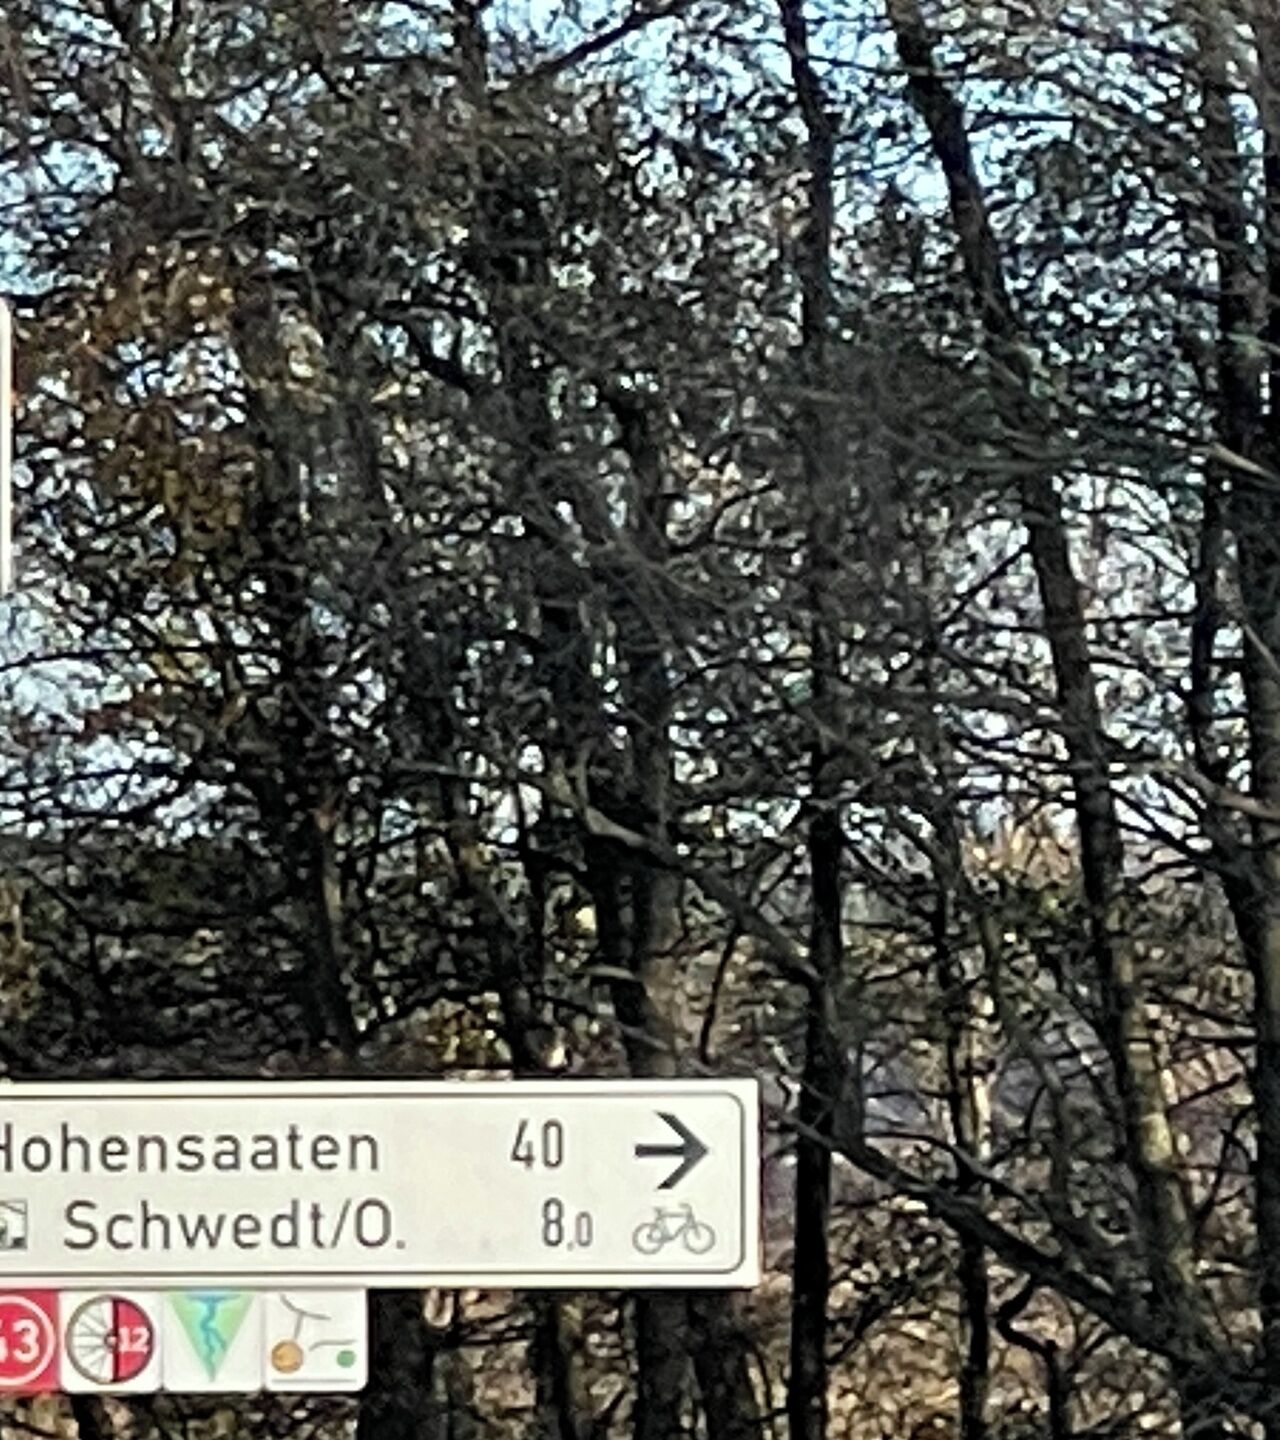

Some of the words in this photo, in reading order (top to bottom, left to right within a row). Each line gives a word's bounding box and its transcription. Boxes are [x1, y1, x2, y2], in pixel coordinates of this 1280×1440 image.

[510, 1118, 563, 1170] 40
[63, 1198, 407, 1250] Schwedt/O.
[117, 1326, 151, 1354] 12
